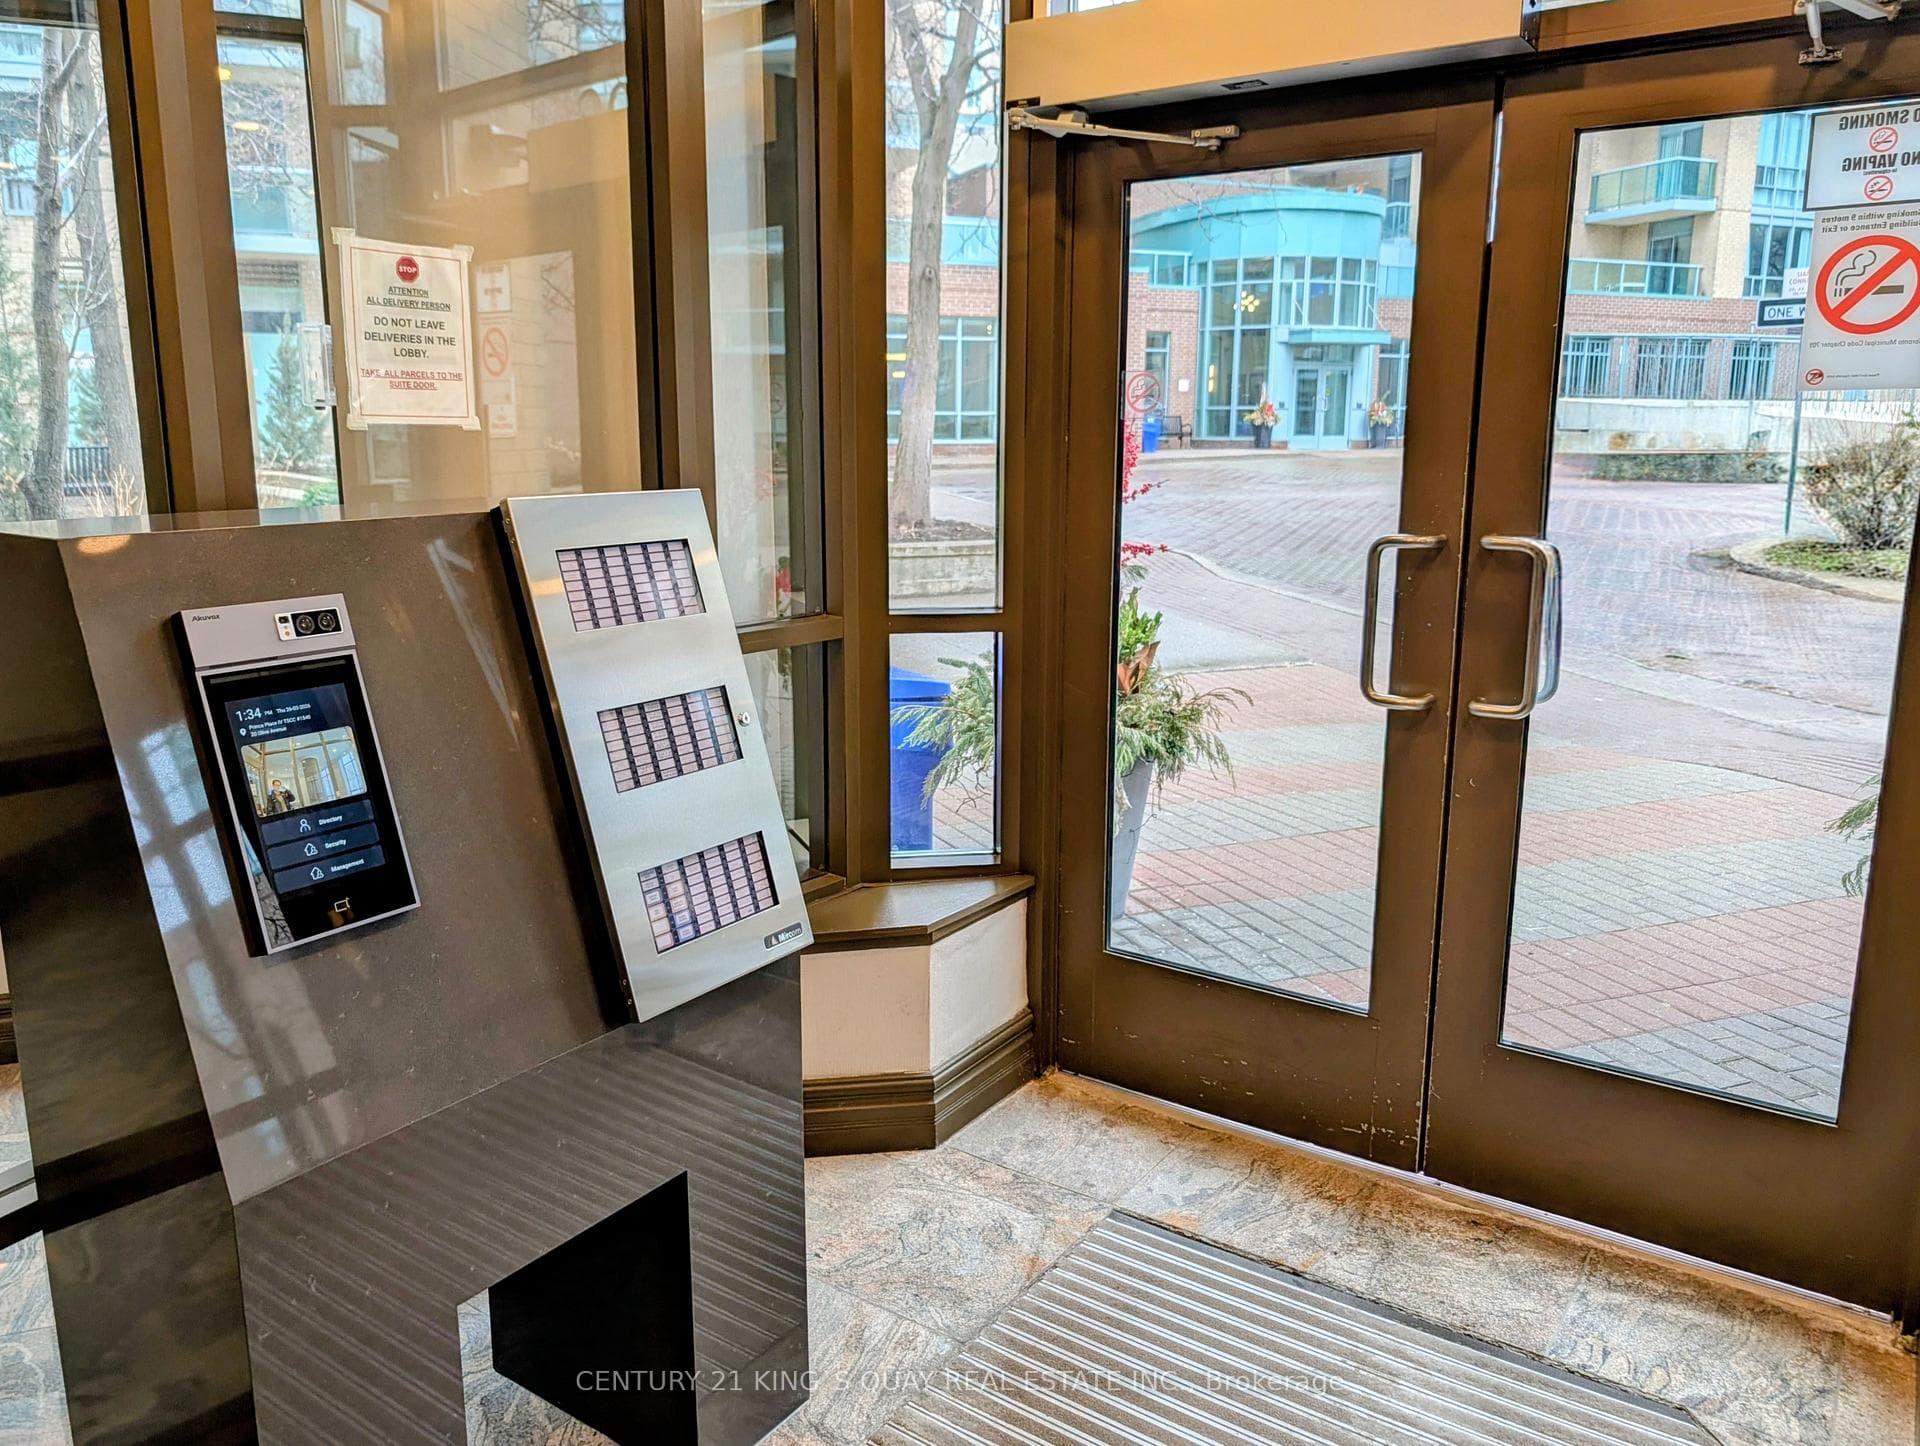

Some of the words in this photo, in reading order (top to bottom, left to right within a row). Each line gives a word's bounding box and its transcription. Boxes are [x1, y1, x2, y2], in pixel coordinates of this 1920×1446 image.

[398, 265, 417, 273] STOP
[388, 286, 429, 297] ATTENTION
[366, 296, 381, 305] ALL
[383, 298, 420, 308] DELIVERY
[421, 301, 451, 312] PERSON
[1768, 306, 1793, 318] ONE
[374, 316, 388, 326] DO
[391, 318, 412, 328] NOT
[415, 320, 445, 330] LEAVE
[364, 331, 422, 344] DELIVERIES
[425, 336, 434, 345] IN
[436, 336, 456, 346] THE
[393, 347, 429, 358] LOBBY.
[361, 368, 381, 377] TAKE
[384, 370, 399, 379] ALL
[400, 370, 435, 380] PARCELS
[436, 372, 447, 380] TO
[449, 372, 463, 381] THE
[389, 381, 412, 390] SUITE
[235, 707, 262, 722] 1:34
[318, 815, 343, 826] Directory
[325, 839, 346, 849] Security
[331, 859, 364, 872] Management
